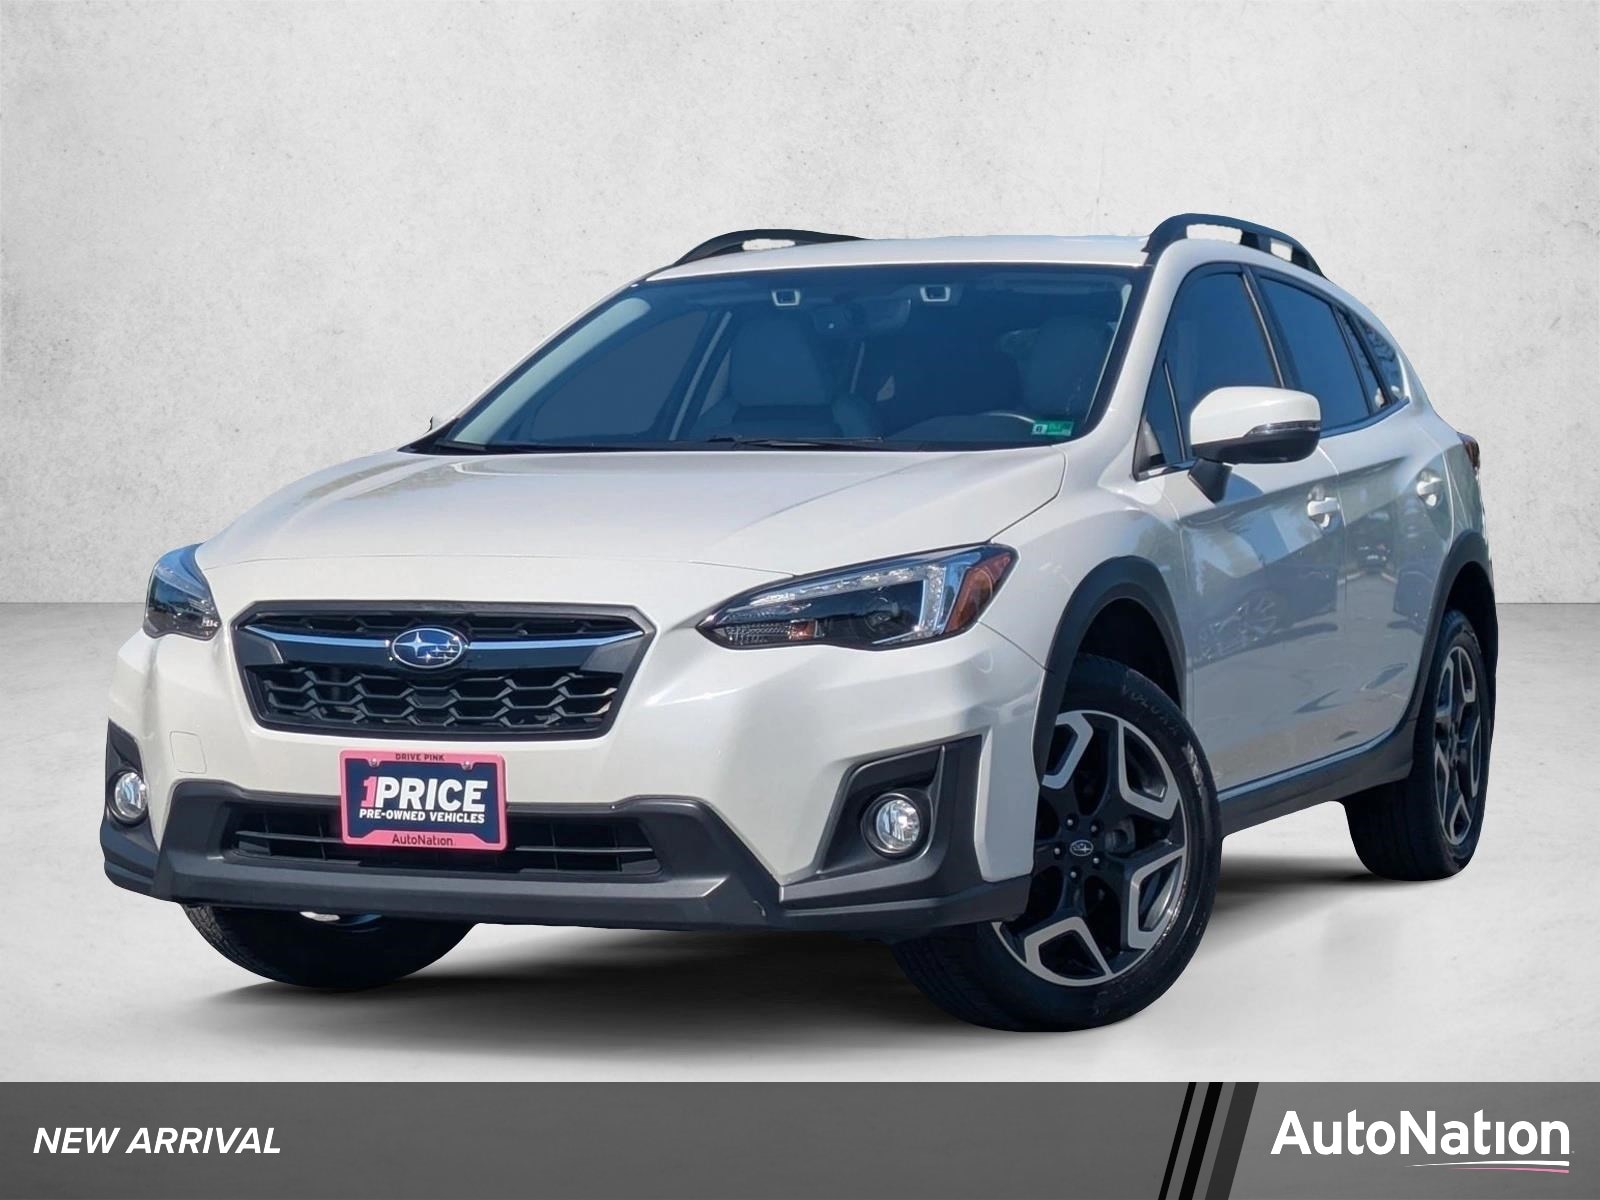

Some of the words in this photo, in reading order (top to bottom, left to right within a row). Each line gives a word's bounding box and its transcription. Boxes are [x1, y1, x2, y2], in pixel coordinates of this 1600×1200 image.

[395, 753, 421, 761] DRIVE
[424, 753, 445, 761] PINK
[359, 808, 426, 821] PRE-OWNED
[429, 812, 485, 824] VEHICLES
[392, 833, 454, 846] AutoNation
